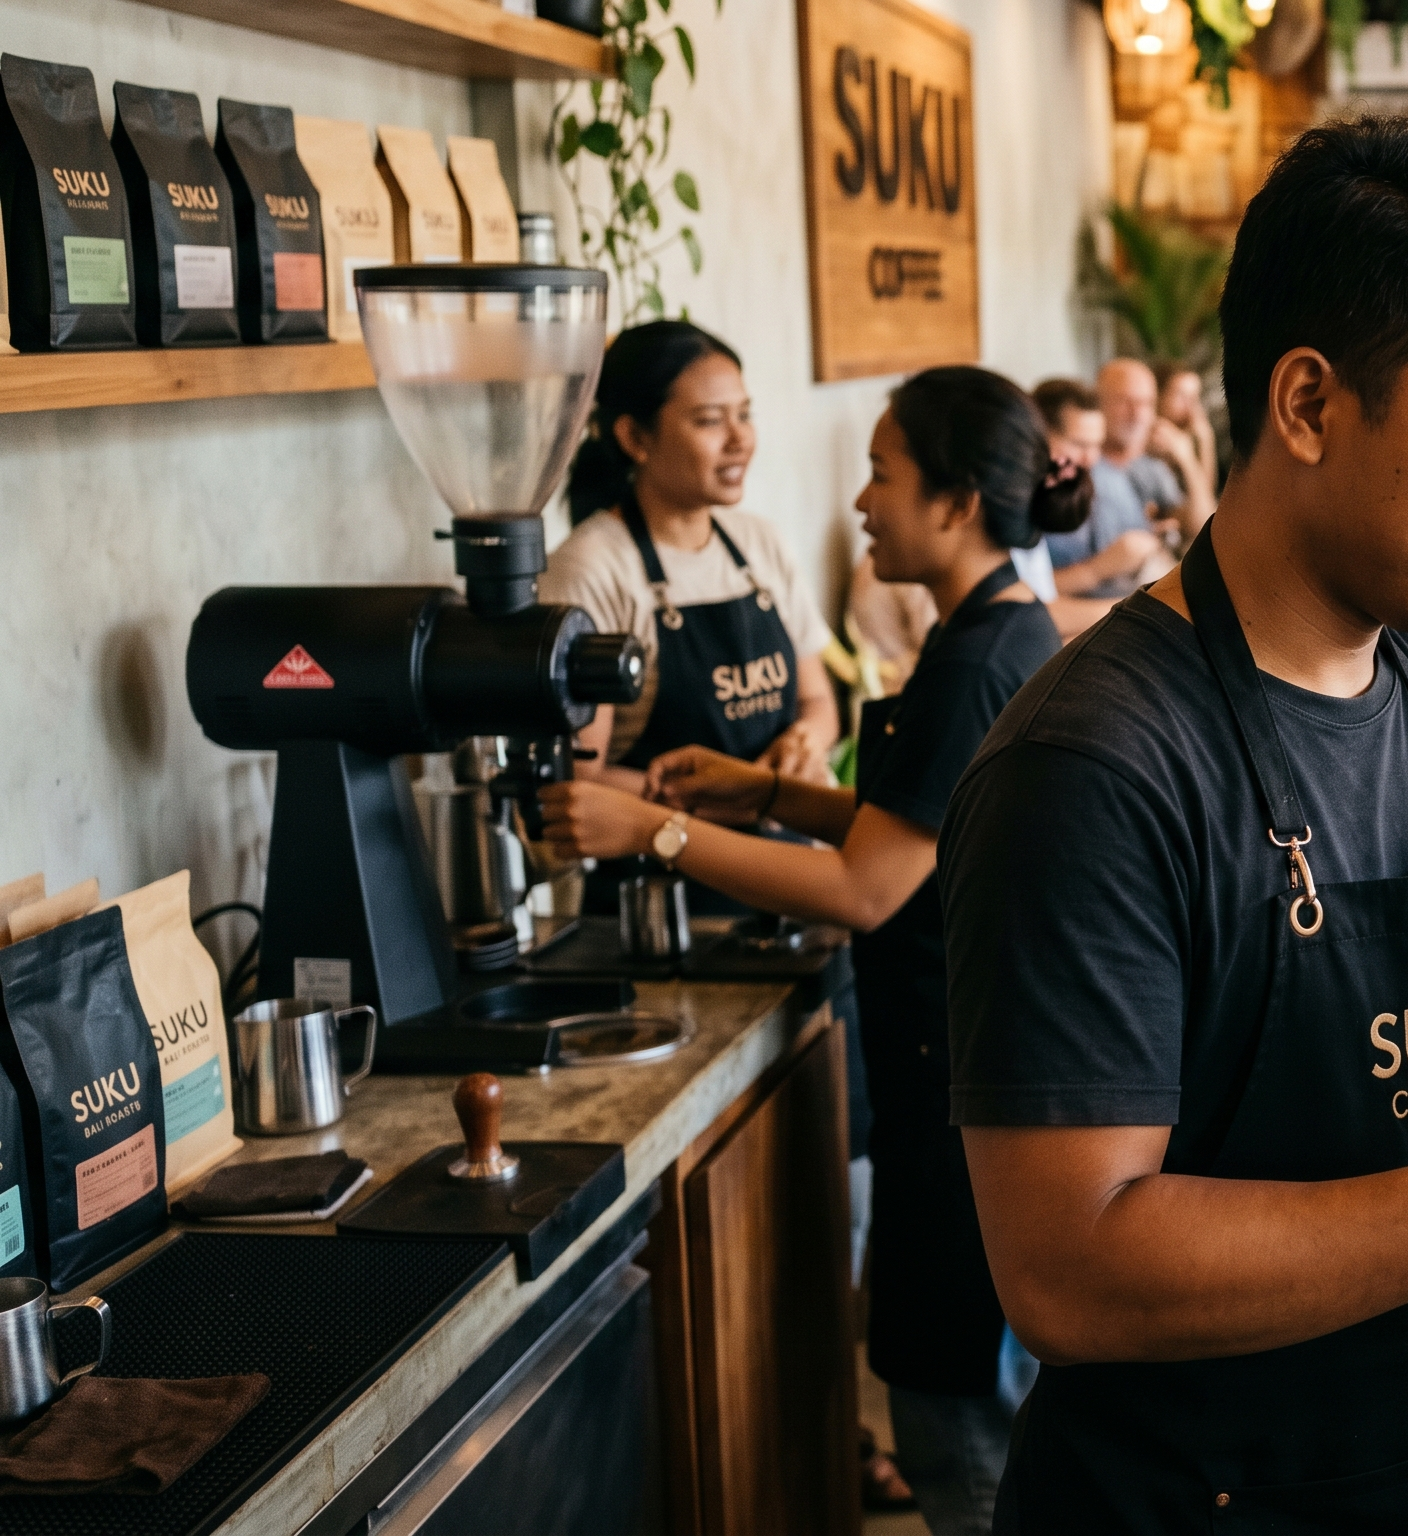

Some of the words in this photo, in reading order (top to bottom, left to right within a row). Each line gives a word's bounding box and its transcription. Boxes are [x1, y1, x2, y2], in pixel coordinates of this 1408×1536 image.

[832, 44, 960, 214] SUKU
[53, 167, 111, 198] SUKU
[167, 182, 219, 211] SUKU
[264, 193, 310, 220] SUKU
[711, 650, 789, 702] SUKU
[724, 690, 783, 721] COFFEE
[150, 1000, 209, 1052] SUKU
[70, 1061, 141, 1124] SUKU
[83, 1120, 105, 1140] BALI
